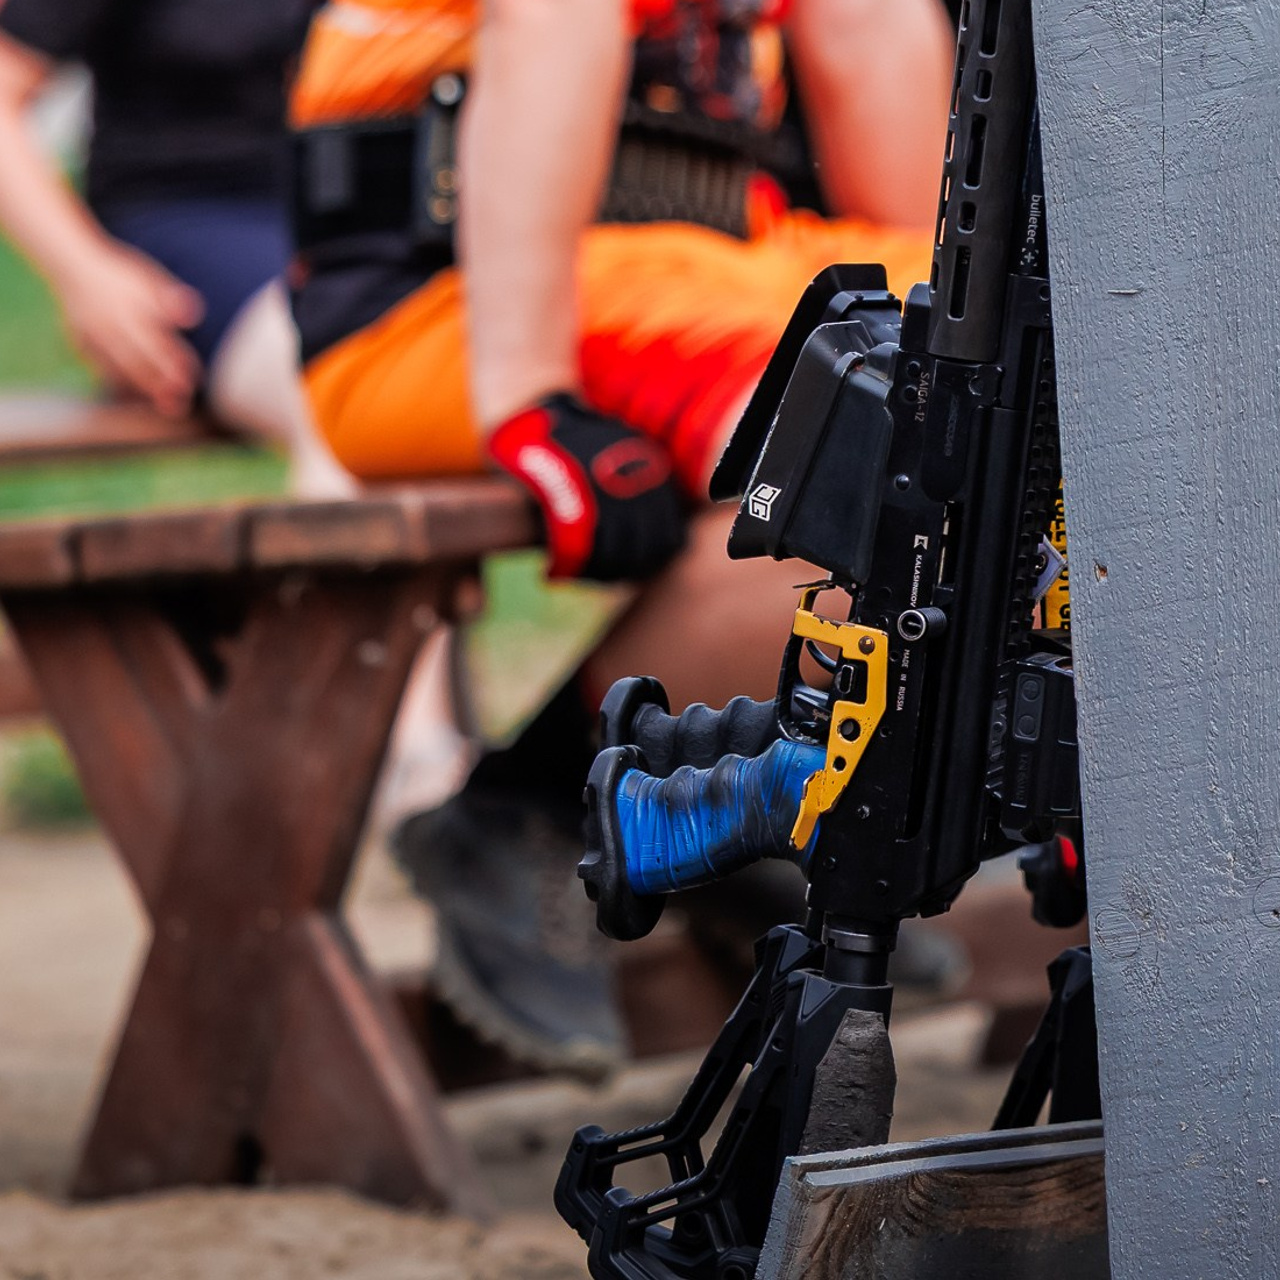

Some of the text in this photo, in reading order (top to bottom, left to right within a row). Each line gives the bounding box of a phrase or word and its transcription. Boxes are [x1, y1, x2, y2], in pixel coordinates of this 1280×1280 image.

[1026, 194, 1043, 244] bulletec
[914, 372, 930, 422] SAIGA-12
[910, 554, 923, 608] KALASHNIKOV
[896, 649, 911, 712] MADE IN RUSSIA
